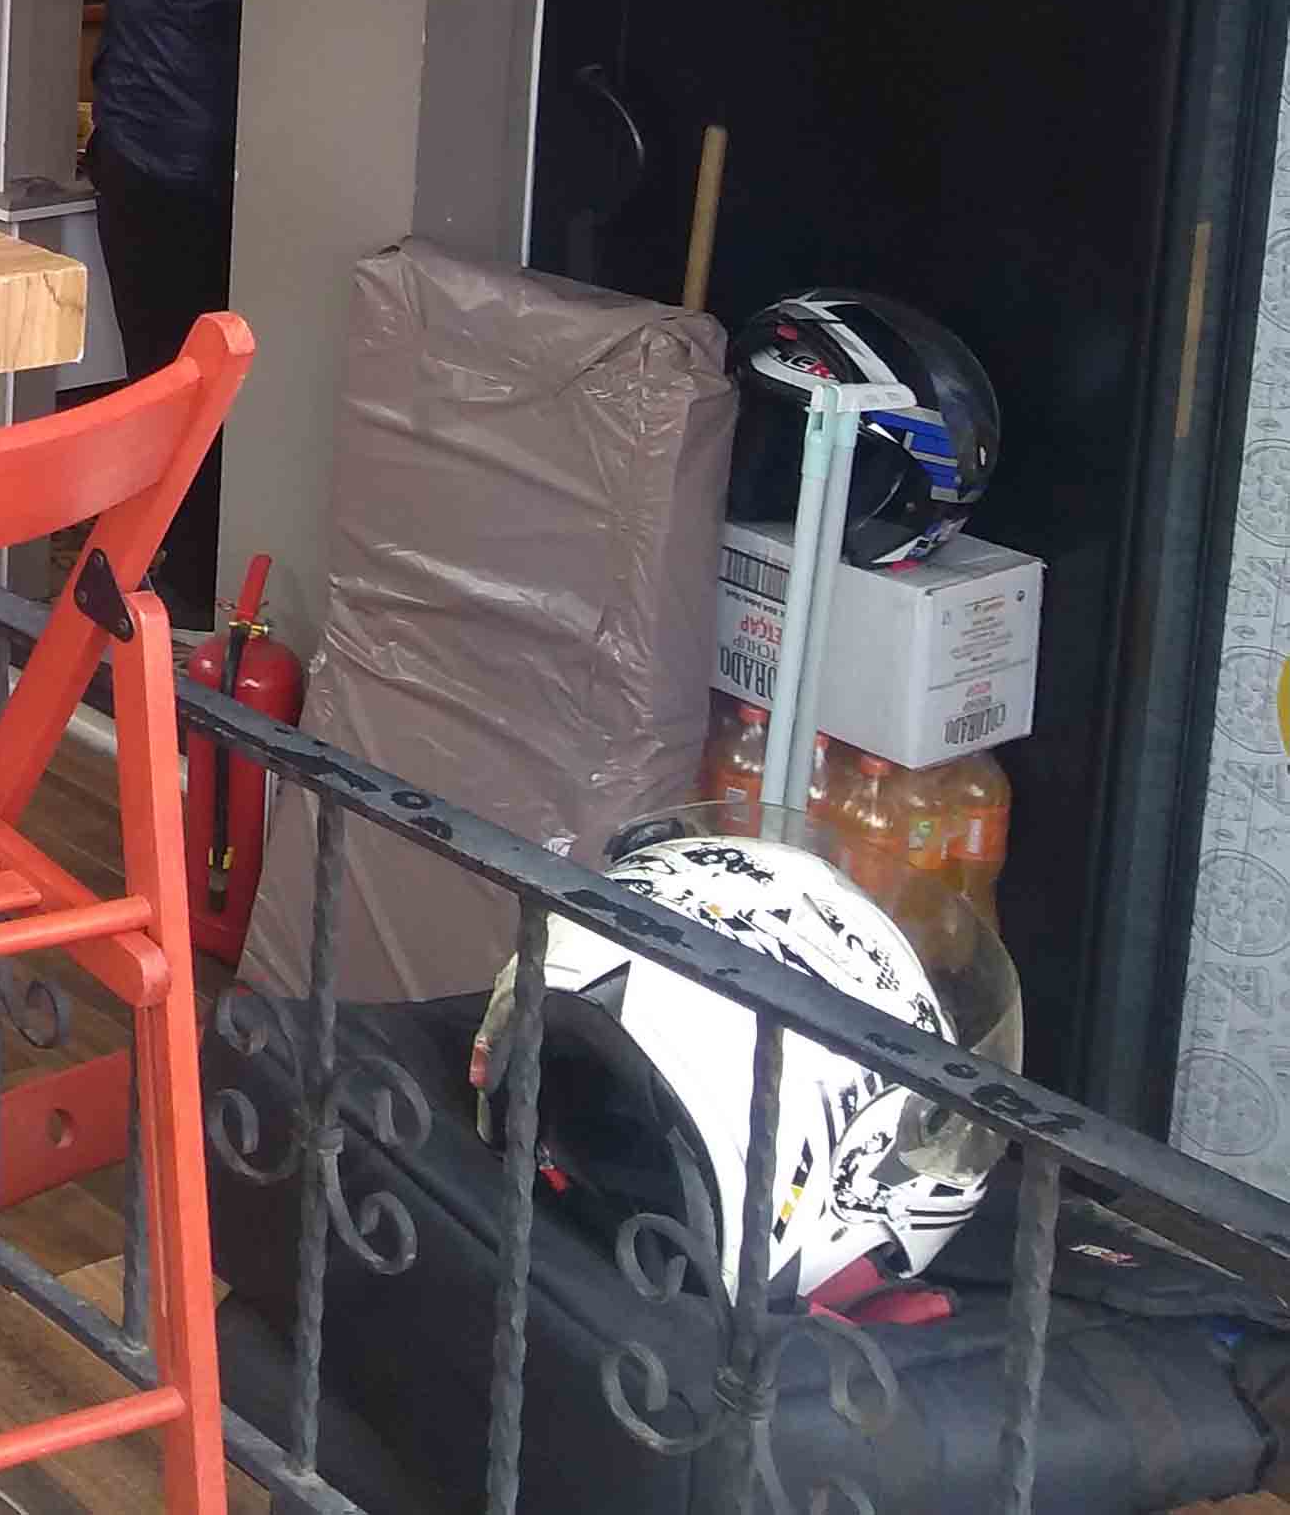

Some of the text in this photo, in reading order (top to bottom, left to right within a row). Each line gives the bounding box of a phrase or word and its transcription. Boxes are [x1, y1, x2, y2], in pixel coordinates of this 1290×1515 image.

[740, 615, 782, 646] ETÇAP
[733, 634, 779, 663] TCHUP
[720, 646, 777, 702] ORADO
